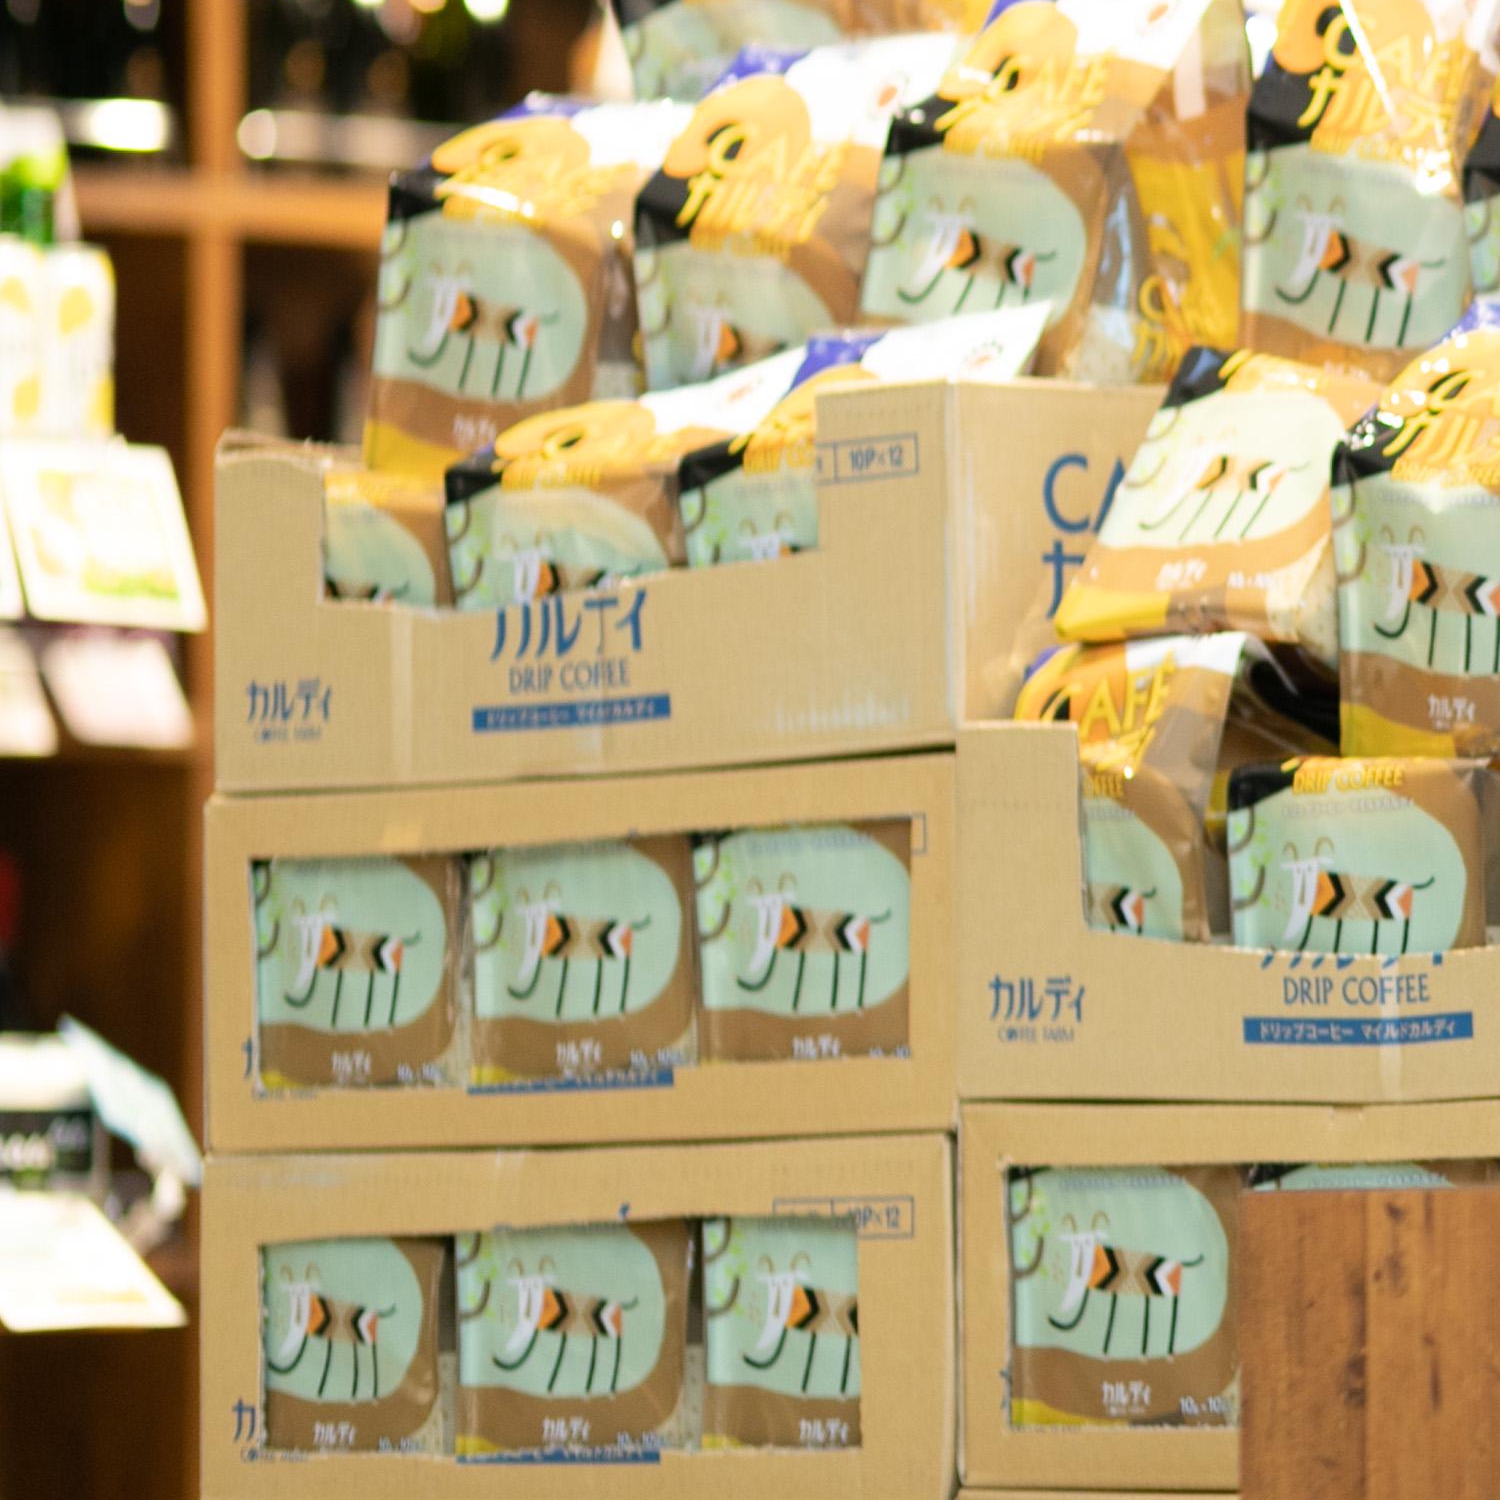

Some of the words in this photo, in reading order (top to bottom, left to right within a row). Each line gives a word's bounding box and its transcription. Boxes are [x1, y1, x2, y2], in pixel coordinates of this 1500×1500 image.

[509, 666, 552, 694] DRIP
[559, 657, 629, 691] COFFEE
[244, 677, 332, 724] カルディ
[1428, 694, 1476, 722] カルディ
[1292, 768, 1331, 794] DRIP
[1336, 763, 1406, 792] COFFEE
[989, 973, 1085, 1023] カルディ
[1282, 975, 1334, 1006] DRIP
[1341, 973, 1431, 1006] COFFEE
[1259, 1021, 1354, 1041] ドリップコーヒー
[1361, 1018, 1457, 1038] マイルドカルディ
[1102, 1380, 1151, 1405] カルディ
[543, 1417, 590, 1442] カルディ
[799, 1418, 849, 1444] カルディ
